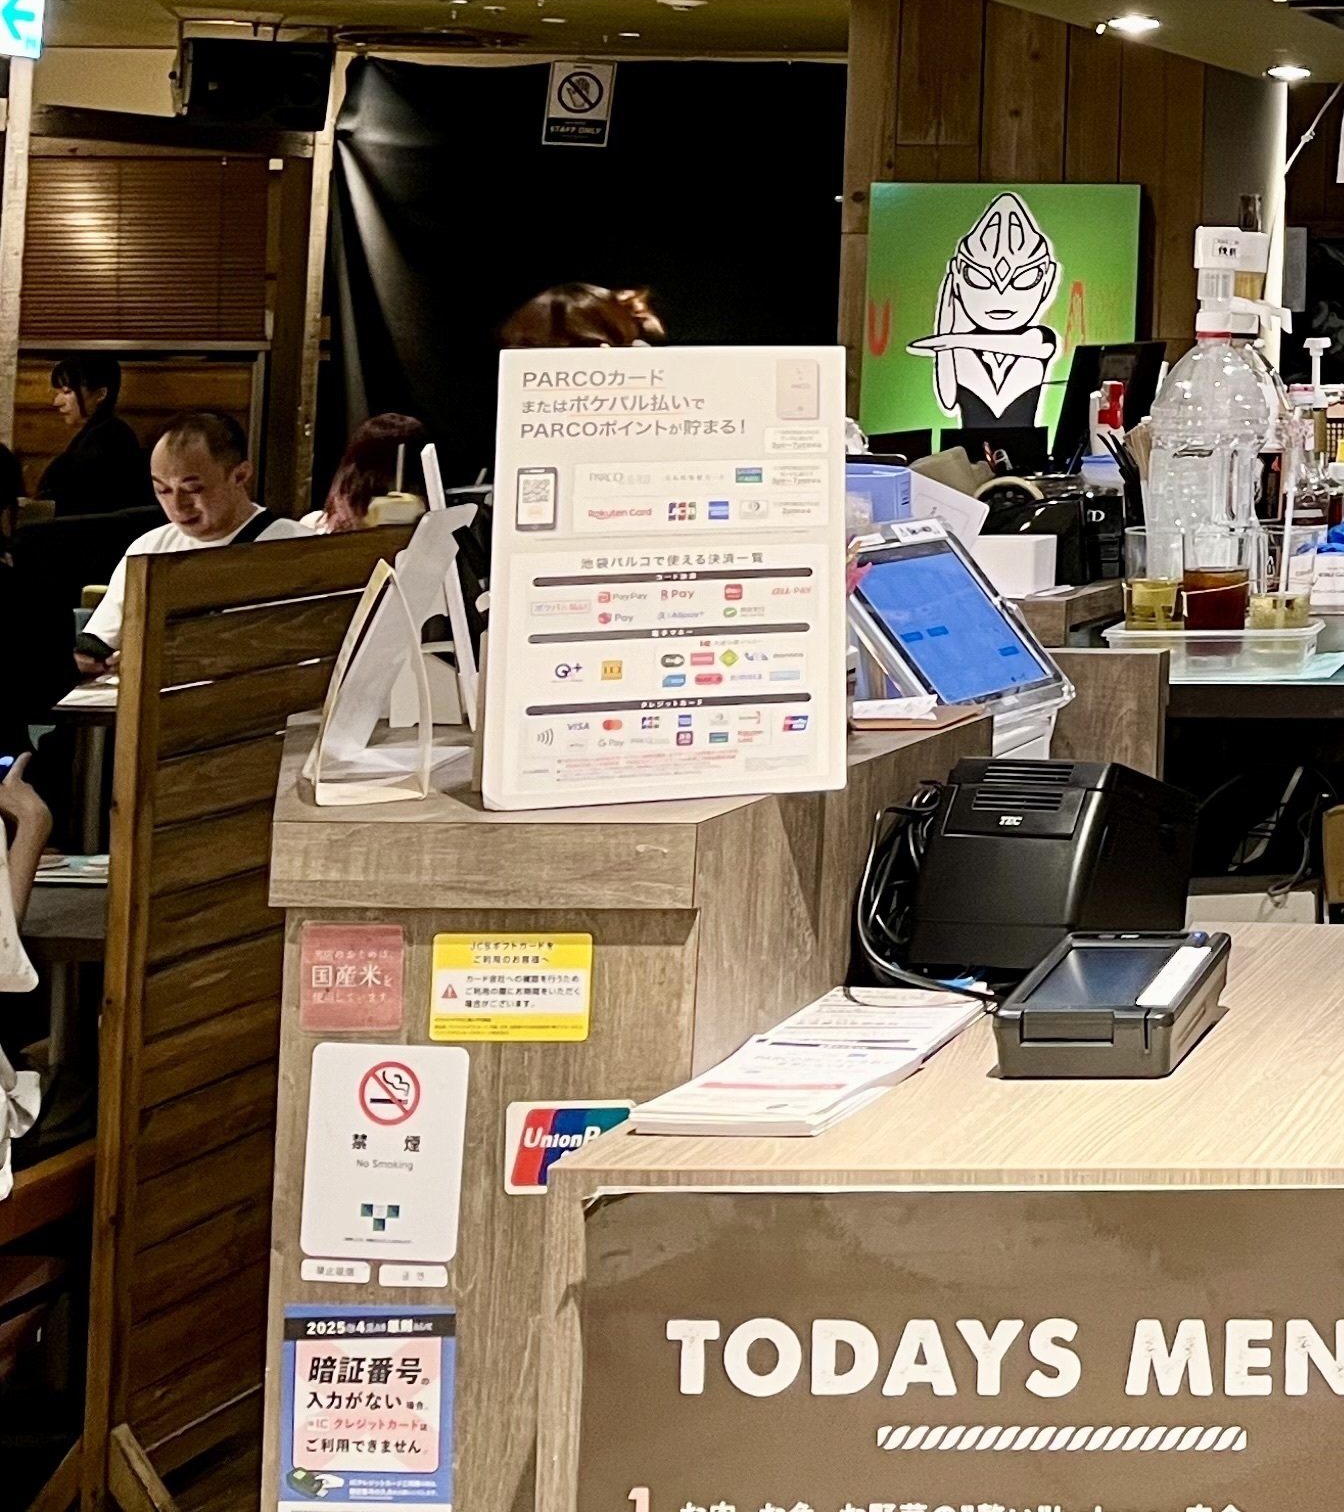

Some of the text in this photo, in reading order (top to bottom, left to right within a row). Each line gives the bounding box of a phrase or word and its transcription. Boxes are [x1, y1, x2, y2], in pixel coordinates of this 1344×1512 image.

[522, 368, 665, 388] PARCOカード
[356, 1159, 414, 1172] No Smoking
[665, 1317, 1083, 1398] TODAYS
